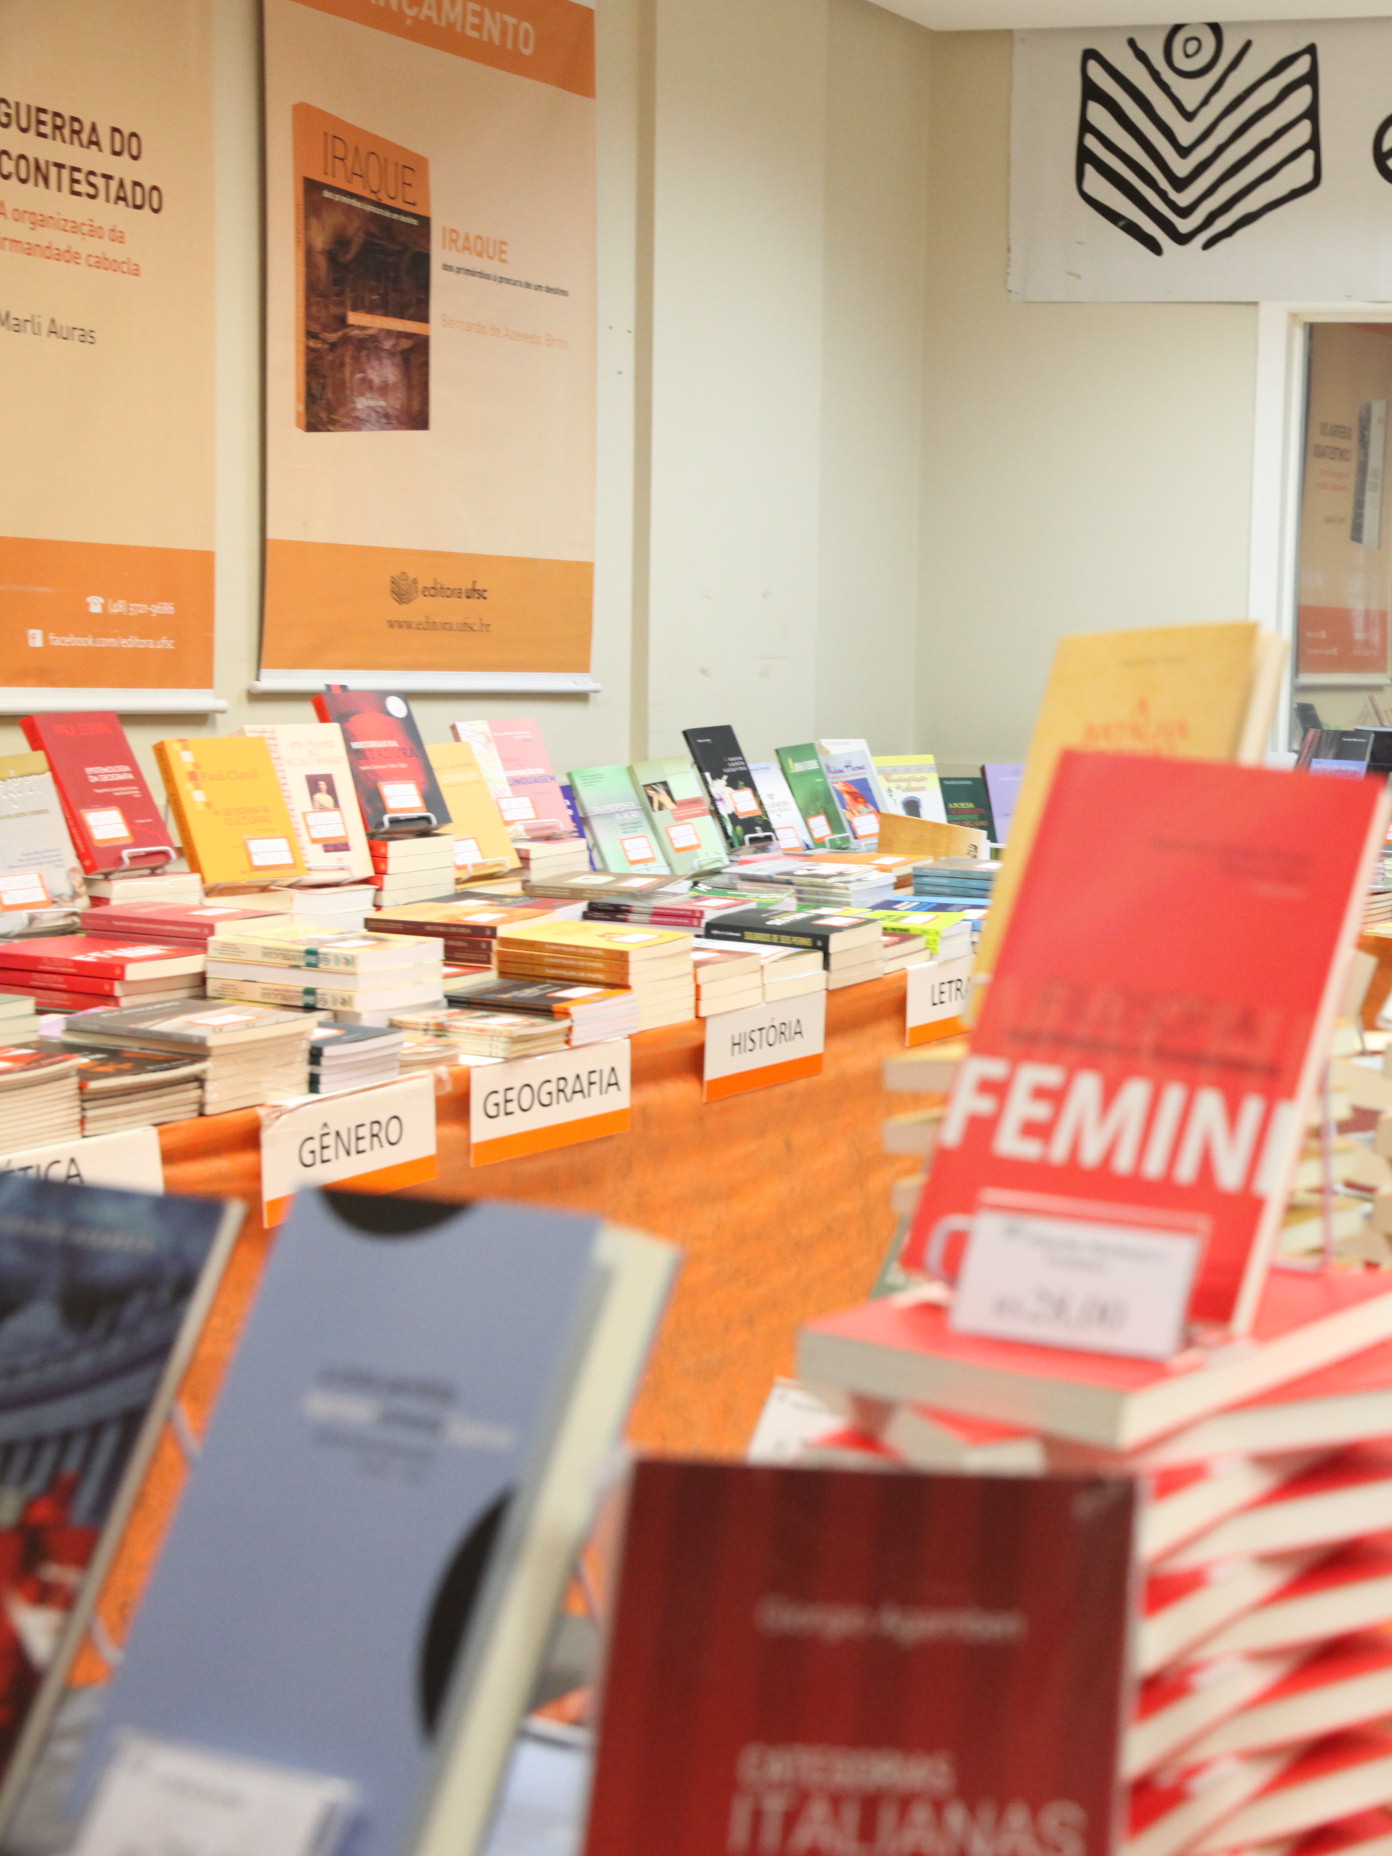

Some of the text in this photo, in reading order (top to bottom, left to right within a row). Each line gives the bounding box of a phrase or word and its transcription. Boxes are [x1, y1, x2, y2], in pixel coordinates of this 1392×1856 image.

[0, 97, 143, 162] GUERRA DO
[0, 149, 164, 214] CONTESTADO
[322, 131, 418, 207] IRAQUE
[12, 207, 106, 241] organização
[108, 223, 127, 245] da
[441, 226, 510, 264] IRAQUE
[0, 232, 142, 277] rmandade cabocla
[0, 309, 97, 345] Marli Auras
[421, 578, 488, 600] editora ufsc
[730, 1016, 804, 1057] HISTÓRIA
[482, 1065, 622, 1120] GEOGRAFIA
[297, 1113, 404, 1170] GÊNERO
